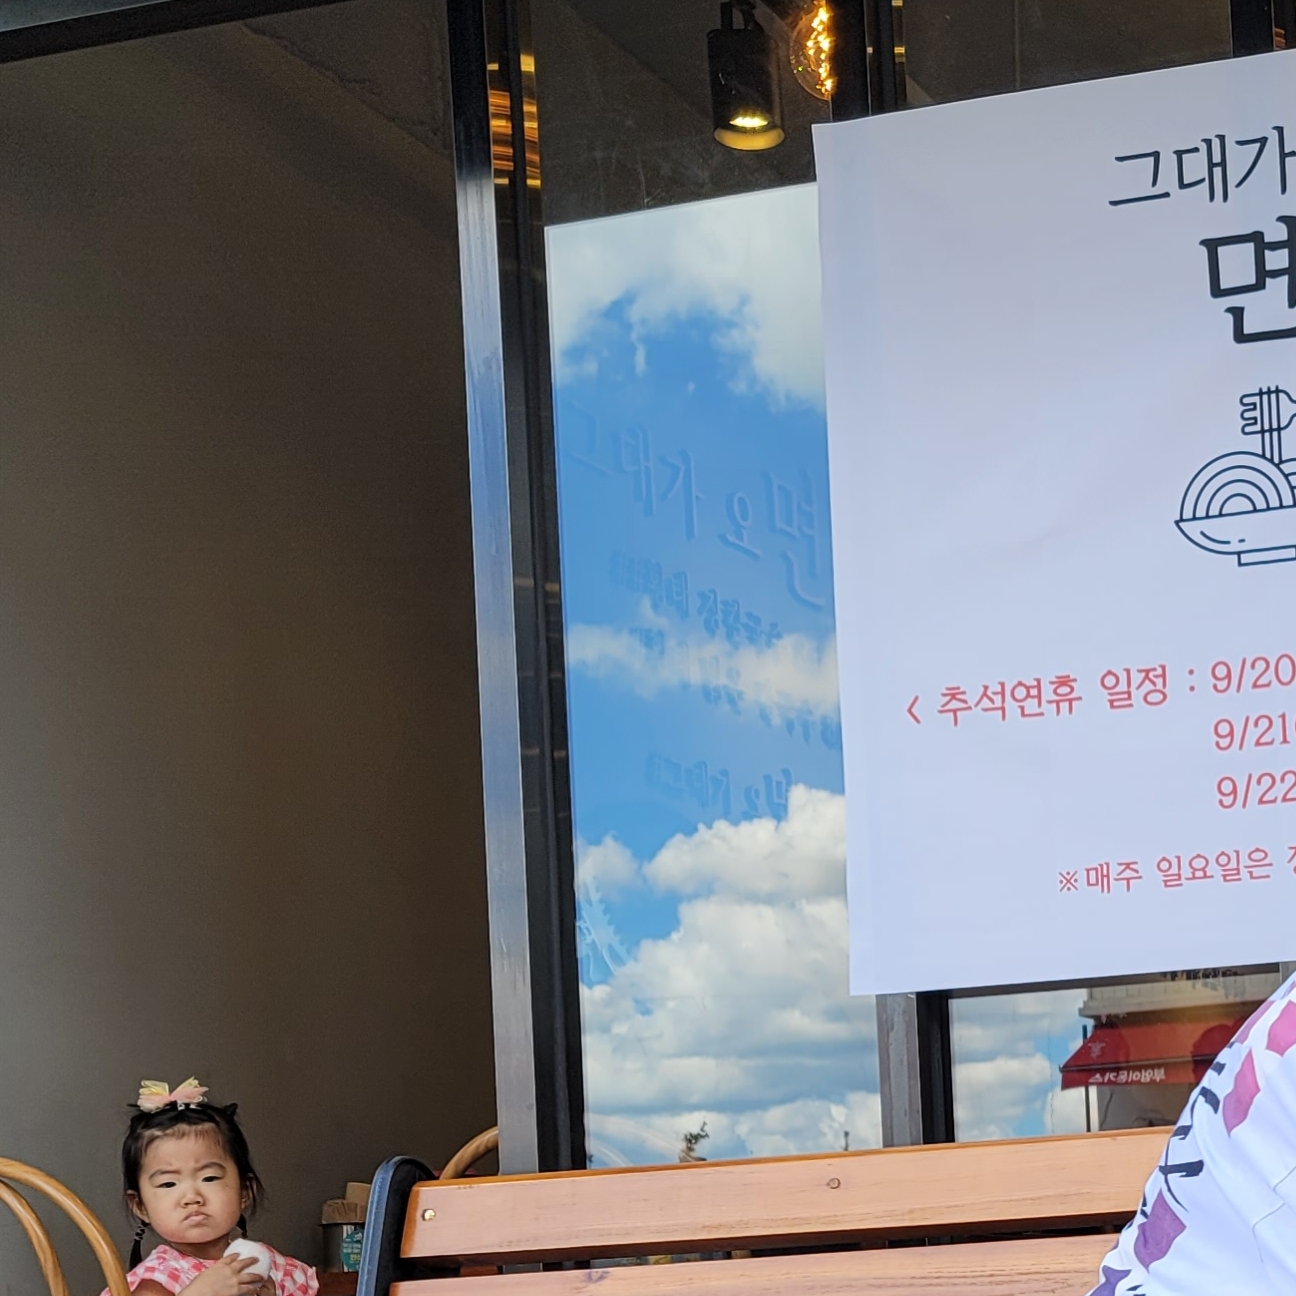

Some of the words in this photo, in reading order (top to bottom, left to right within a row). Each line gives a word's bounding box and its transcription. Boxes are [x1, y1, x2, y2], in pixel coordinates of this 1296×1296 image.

[937, 673, 1084, 728] 추석연휴
[1098, 664, 1170, 711] 일정
[1155, 848, 1273, 890] 일요일은
